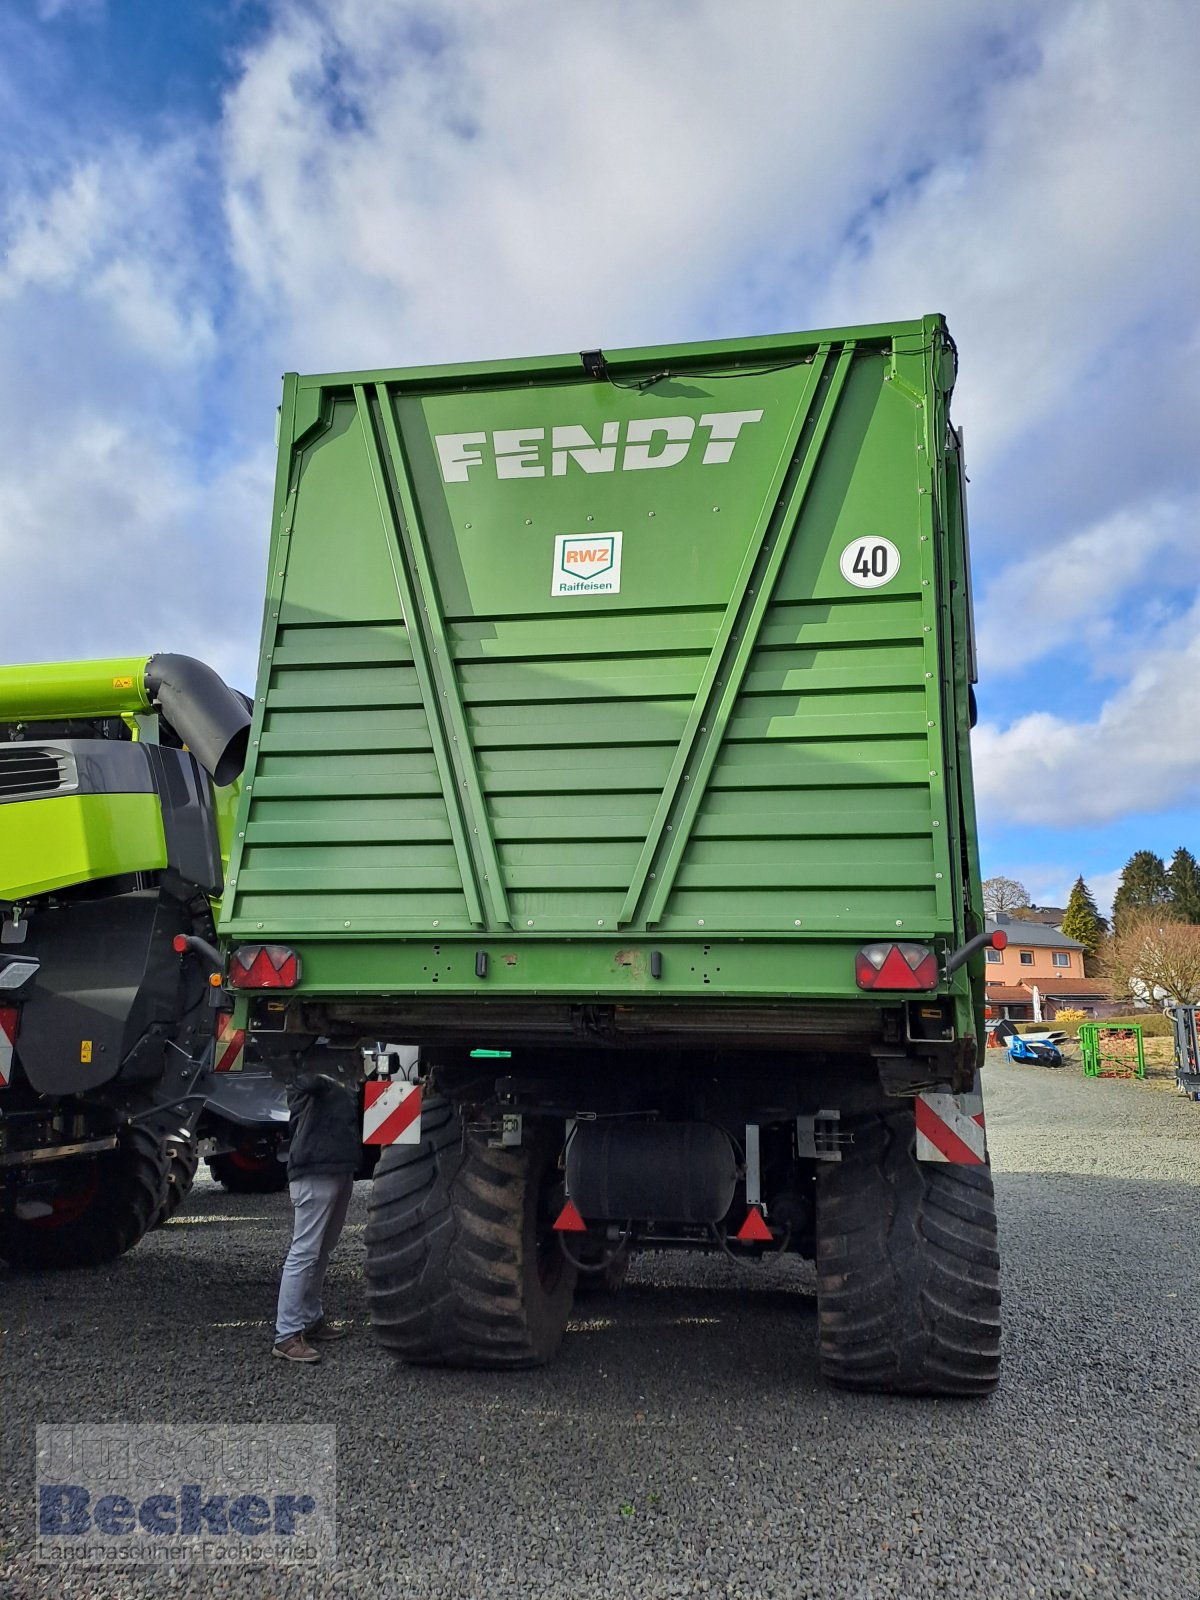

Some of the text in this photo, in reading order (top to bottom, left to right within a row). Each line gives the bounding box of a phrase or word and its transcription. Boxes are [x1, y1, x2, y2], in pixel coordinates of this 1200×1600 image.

[435, 410, 764, 482] FENDT
[566, 548, 609, 564] RWZ
[852, 545, 888, 578] 40
[559, 581, 612, 592] Raiffeisen
